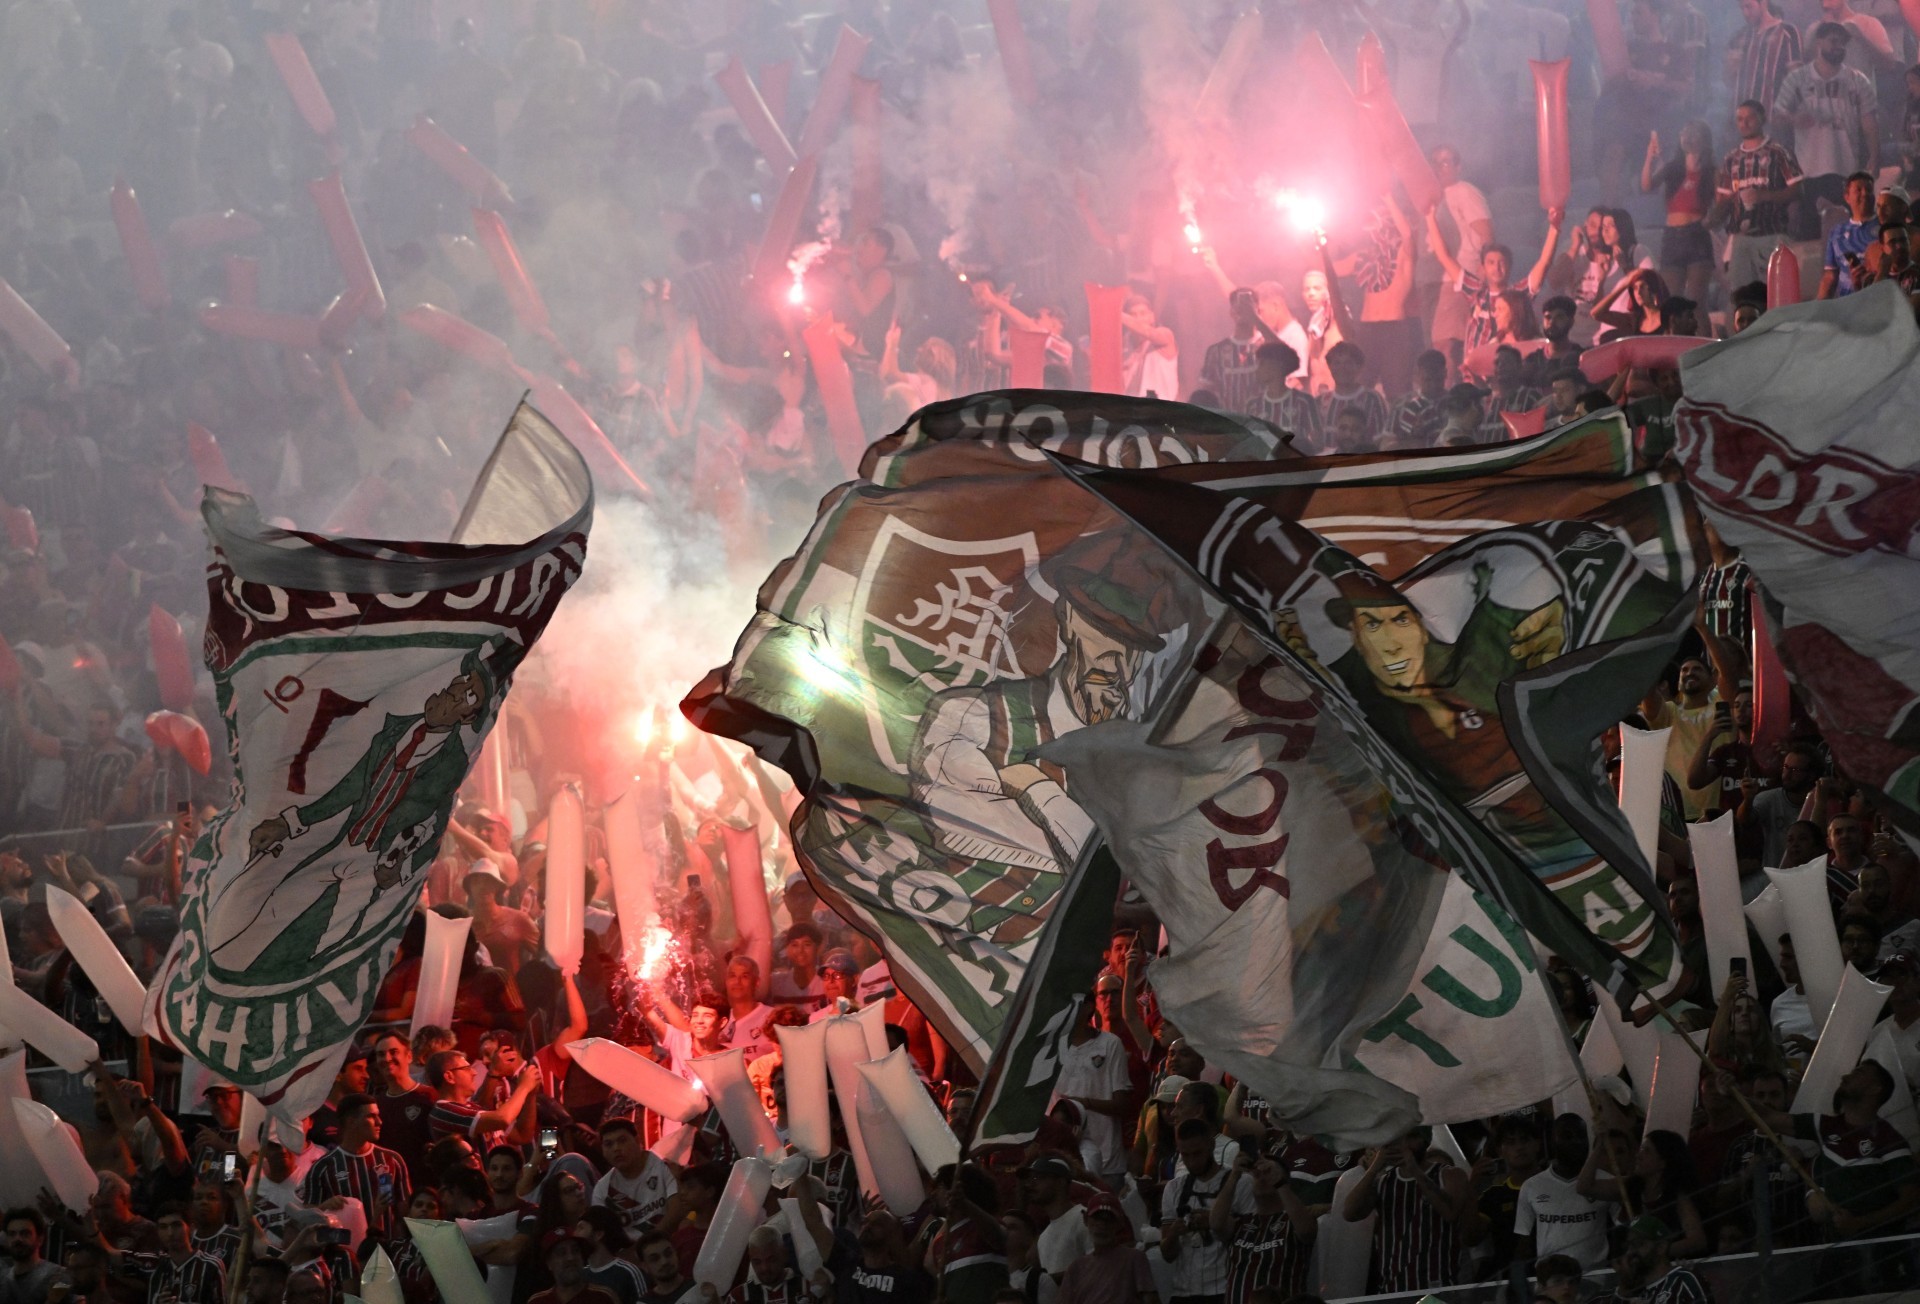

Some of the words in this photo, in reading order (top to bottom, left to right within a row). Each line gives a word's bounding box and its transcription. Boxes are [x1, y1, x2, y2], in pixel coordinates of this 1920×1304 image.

[632, 1197, 667, 1221] BETANO
[1539, 1210, 1598, 1224] SUPERBET
[1235, 1238, 1285, 1252] SUPERBET
